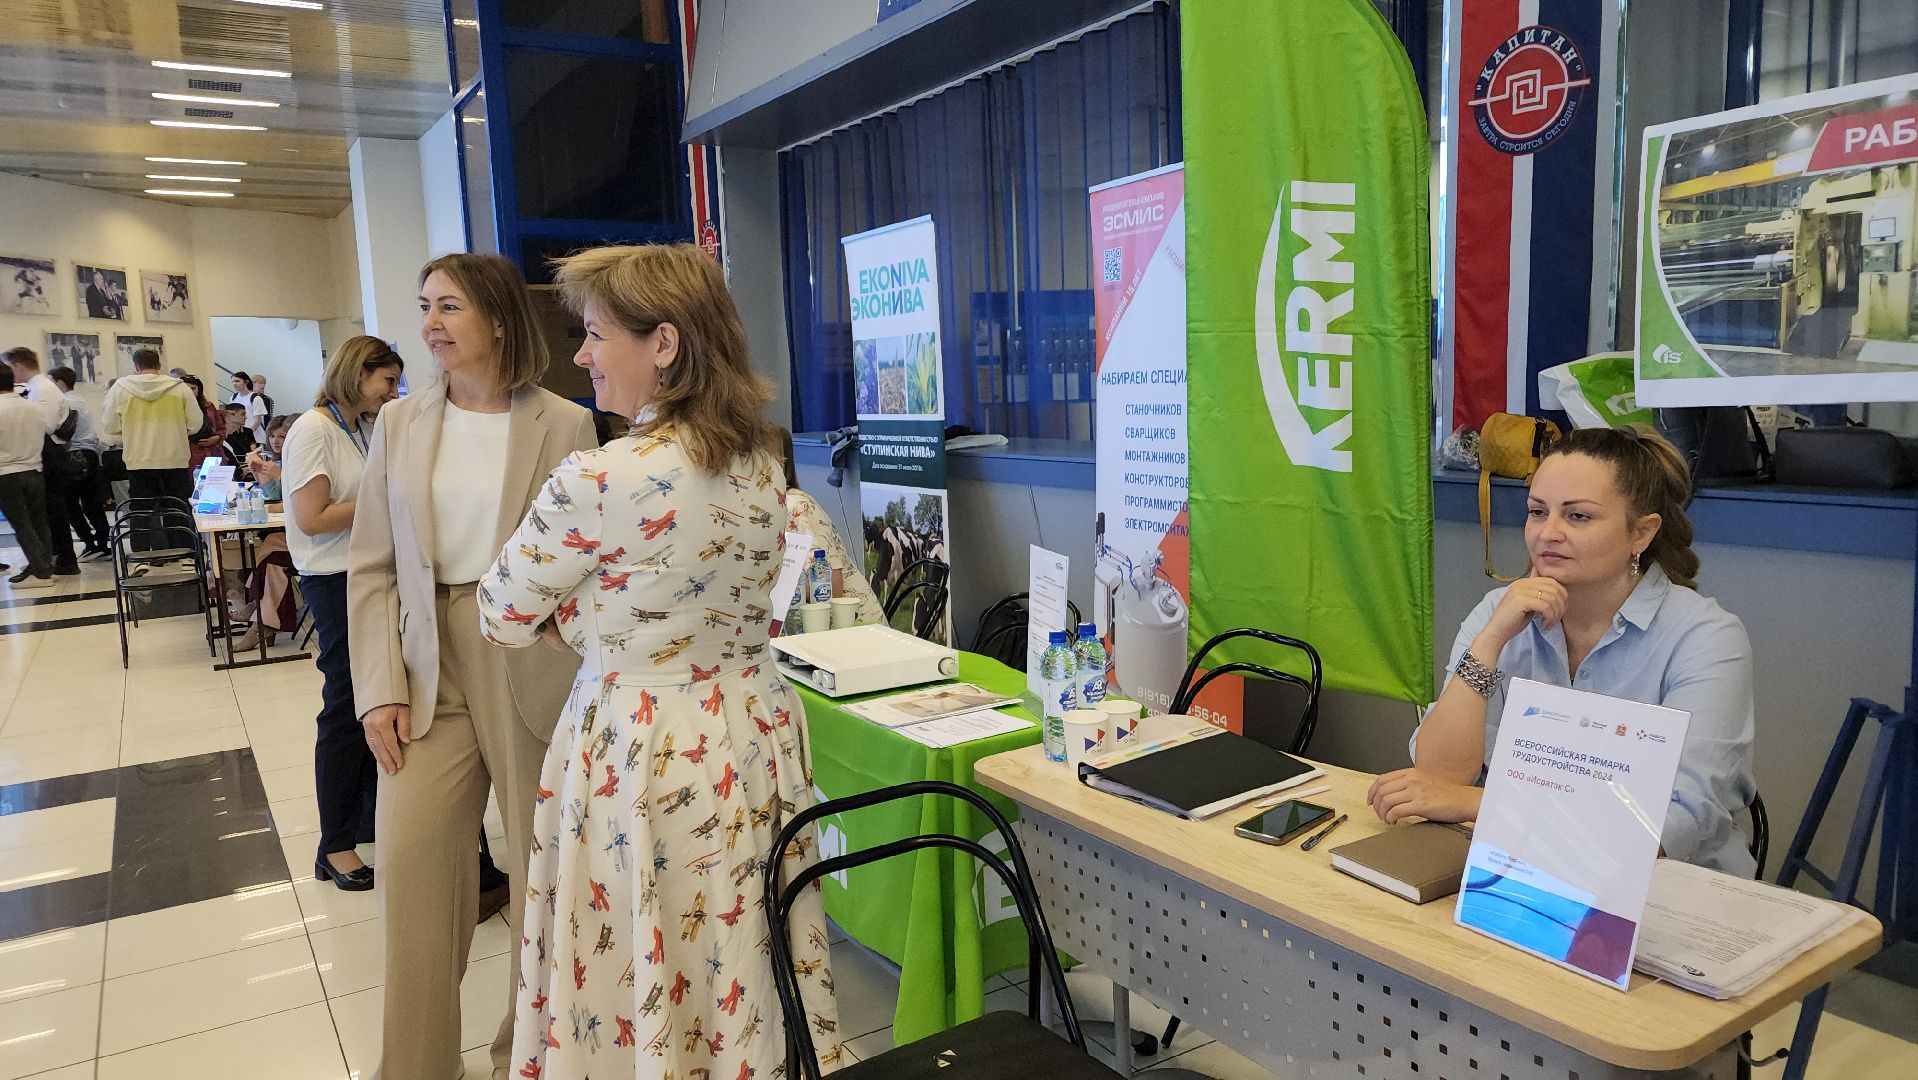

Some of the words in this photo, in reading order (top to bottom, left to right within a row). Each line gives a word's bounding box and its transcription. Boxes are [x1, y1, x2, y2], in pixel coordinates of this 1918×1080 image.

[1478, 117, 1499, 146] ЗАВТРА
[1499, 138, 1544, 151] СТРОИТСЯ
[1545, 100, 1577, 141] СЕГОДНЯ
[1843, 117, 1918, 153] РАБ
[1103, 204, 1165, 233] ЭСМИС
[858, 257, 931, 295] EKONIVA
[851, 286, 926, 322] ЭКОНИВА
[1255, 180, 1356, 473] KERMI
[1101, 370, 1148, 386] НАБИРАЕМ
[1125, 403, 1182, 416] СТАНОЧНИКОВ
[1125, 427, 1176, 441] СВАРЩИКОВ
[860, 443, 908, 458] «СТУПИНСКАЯ
[910, 445, 936, 459] НИВА»
[1125, 450, 1186, 464] МОНТАЖНИКОВ
[1512, 749, 1591, 777] ТРУДОУСТРОЙСТВА
[1592, 770, 1613, 782] 2024
[1514, 737, 1587, 764] ВСЕРОССИЙСКАЯ
[1588, 755, 1631, 774] ЯРМАРКА
[1507, 768, 1525, 781] ООО
